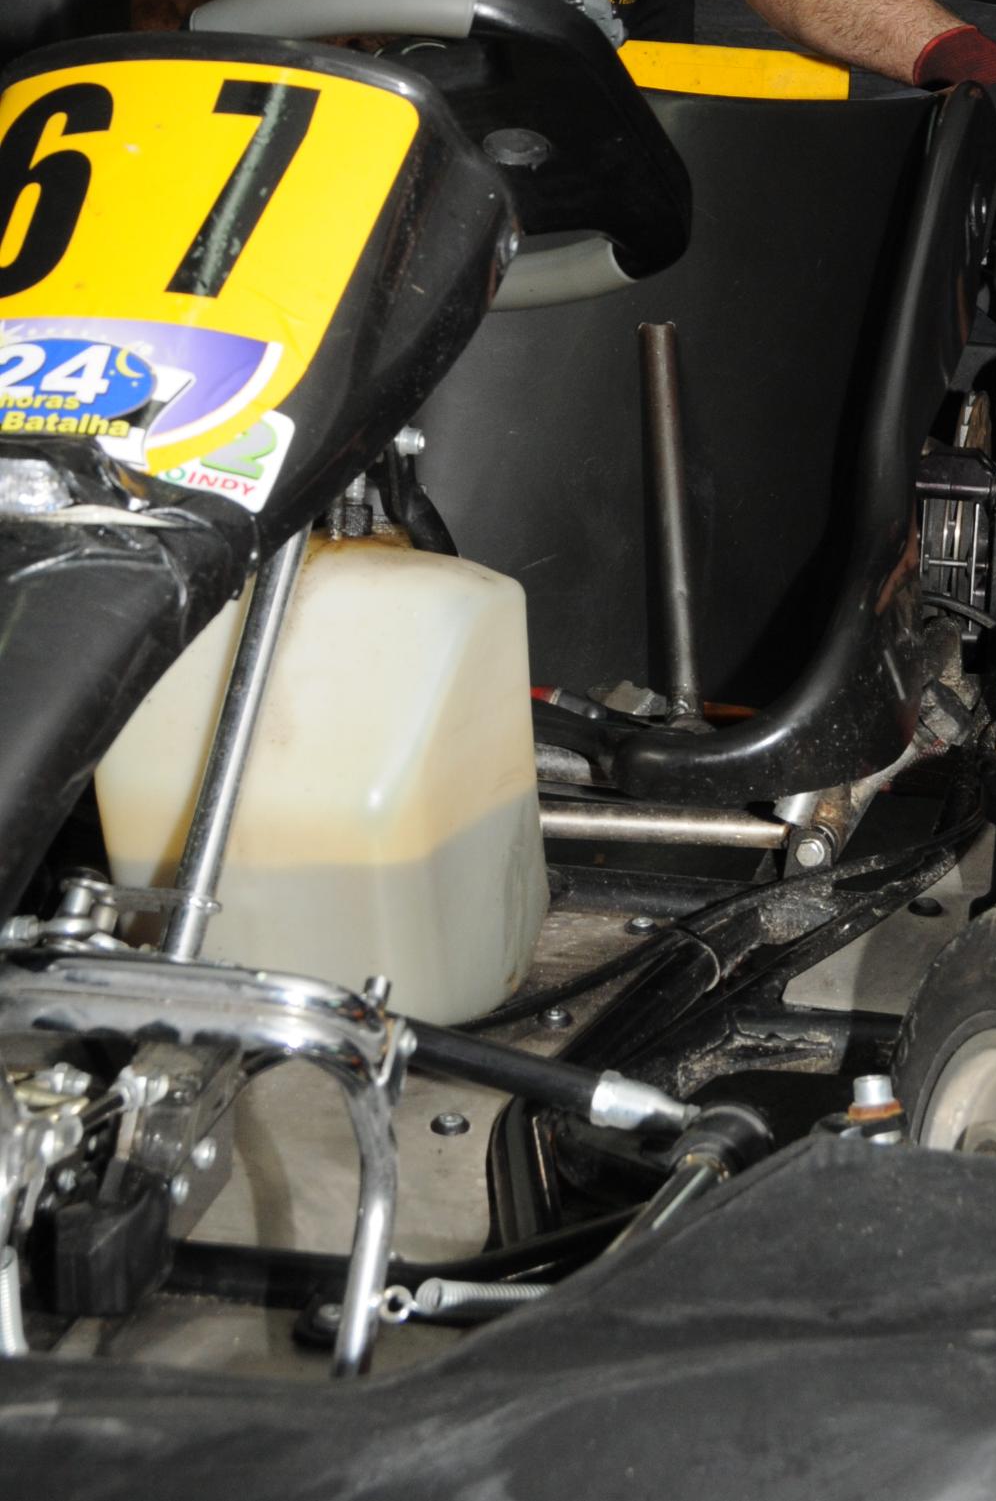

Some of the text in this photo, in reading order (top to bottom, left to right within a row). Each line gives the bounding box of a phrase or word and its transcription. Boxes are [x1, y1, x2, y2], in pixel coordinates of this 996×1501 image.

[0, 79, 321, 300] 67
[0, 343, 111, 405] 24
[0, 392, 81, 411] horas
[0, 411, 131, 439] Batalha
[165, 467, 257, 496] OINDY
